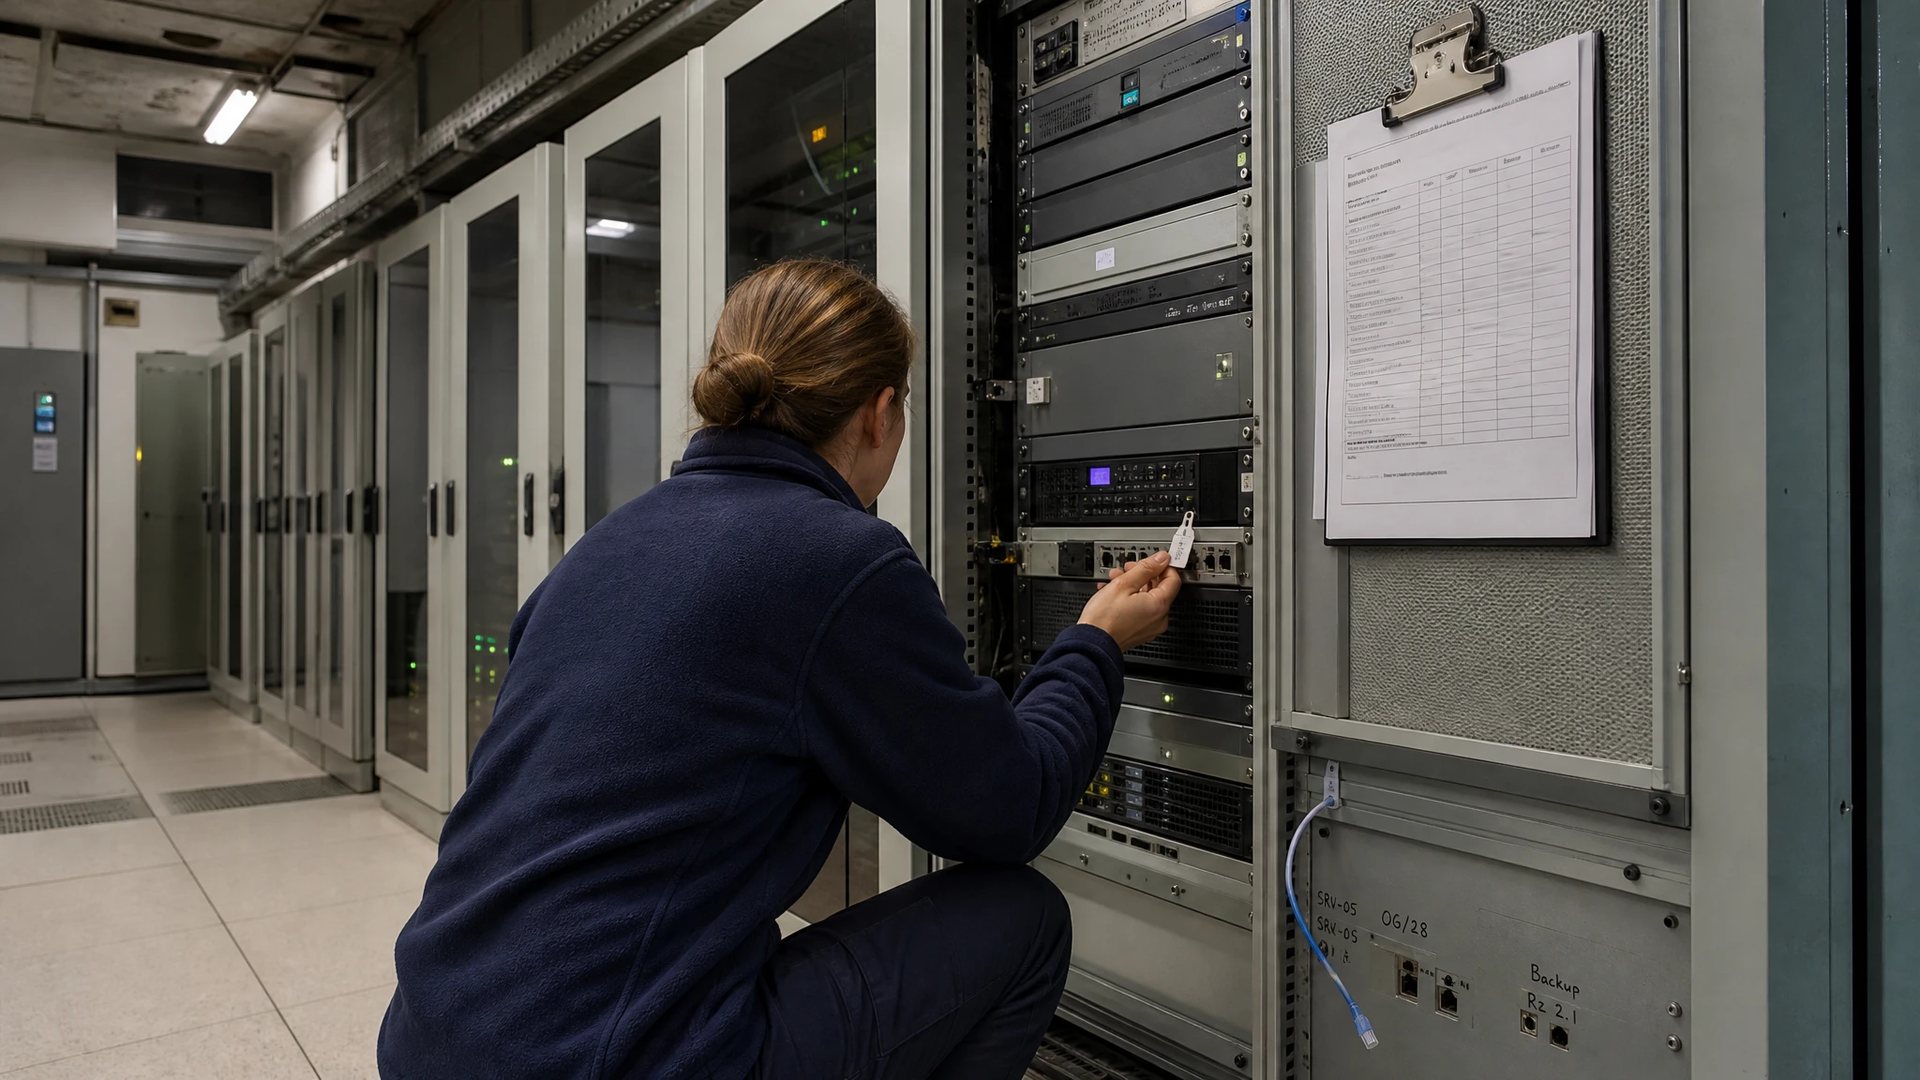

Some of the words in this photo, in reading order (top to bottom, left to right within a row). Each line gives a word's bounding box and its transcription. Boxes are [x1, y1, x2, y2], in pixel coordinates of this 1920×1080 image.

[1317, 890, 1358, 916] SRV-05
[1531, 963, 1580, 1000] Backup
[1555, 1003, 1576, 1025] 2.1
